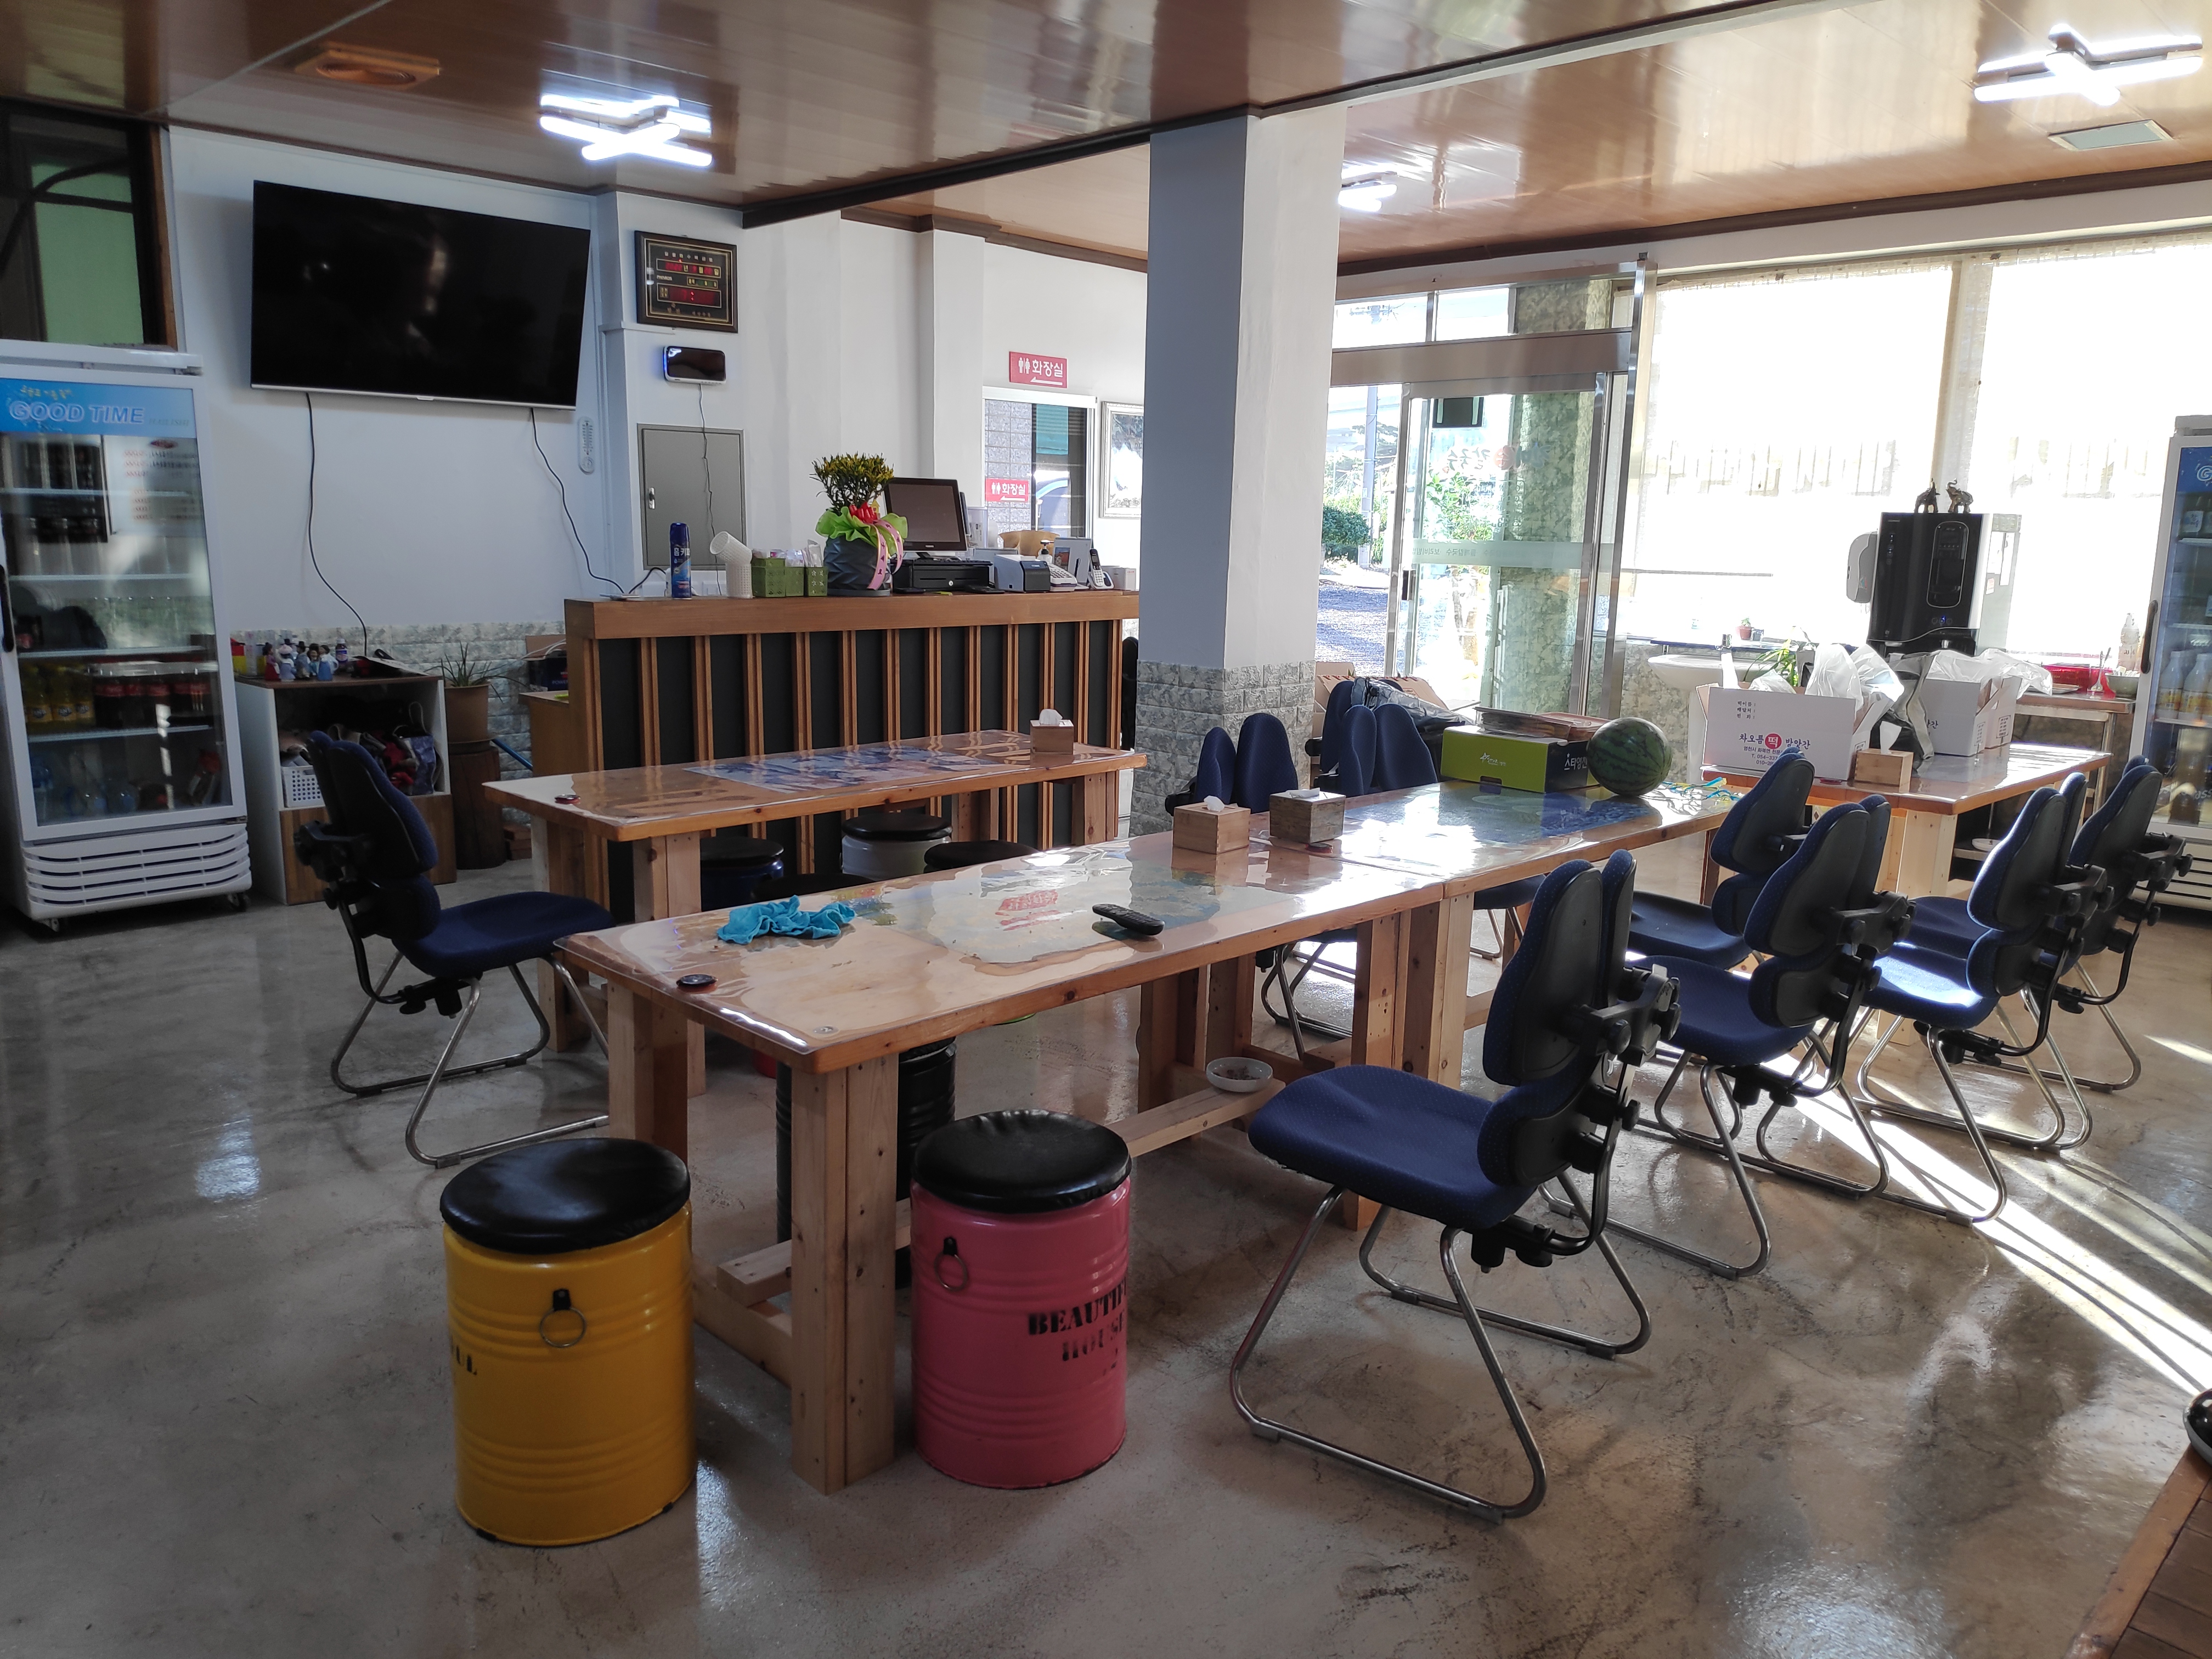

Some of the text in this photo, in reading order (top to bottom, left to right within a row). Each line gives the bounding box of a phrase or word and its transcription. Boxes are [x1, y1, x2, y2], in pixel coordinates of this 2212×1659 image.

[1032, 359, 1063, 378] 화장실
[9, 401, 85, 422] GOOD
[88, 405, 145, 424] TIME
[1002, 484, 1026, 495] 화장실
[1739, 733, 1764, 744] 차오름
[1768, 736, 1779, 748] 떡
